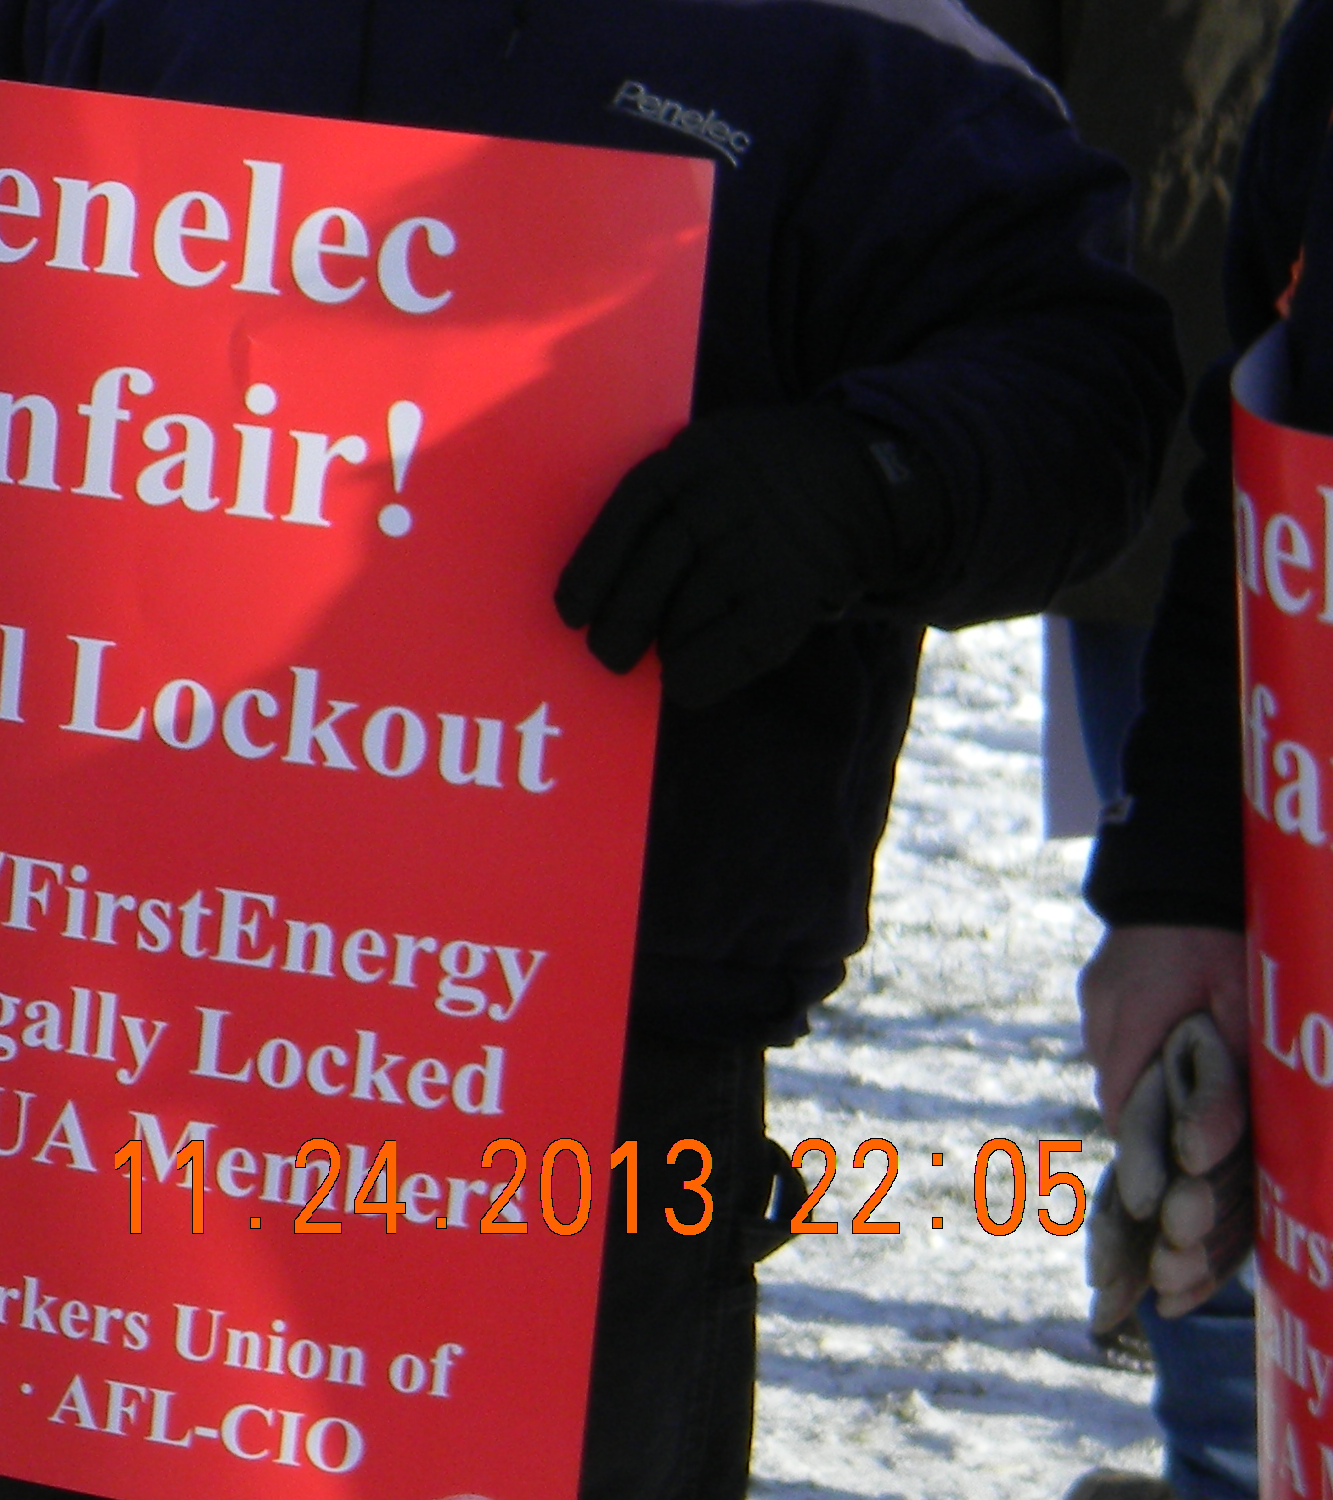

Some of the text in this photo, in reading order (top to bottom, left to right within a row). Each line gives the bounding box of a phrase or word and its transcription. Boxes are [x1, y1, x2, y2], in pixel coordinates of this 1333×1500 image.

[613, 79, 751, 154] Penelec
[59, 634, 564, 795] Lockout
[190, 1005, 505, 1116] Locked
[171, 1303, 367, 1388] Union
[387, 1342, 465, 1400] of
[48, 1373, 367, 1476] AFL-CIO
